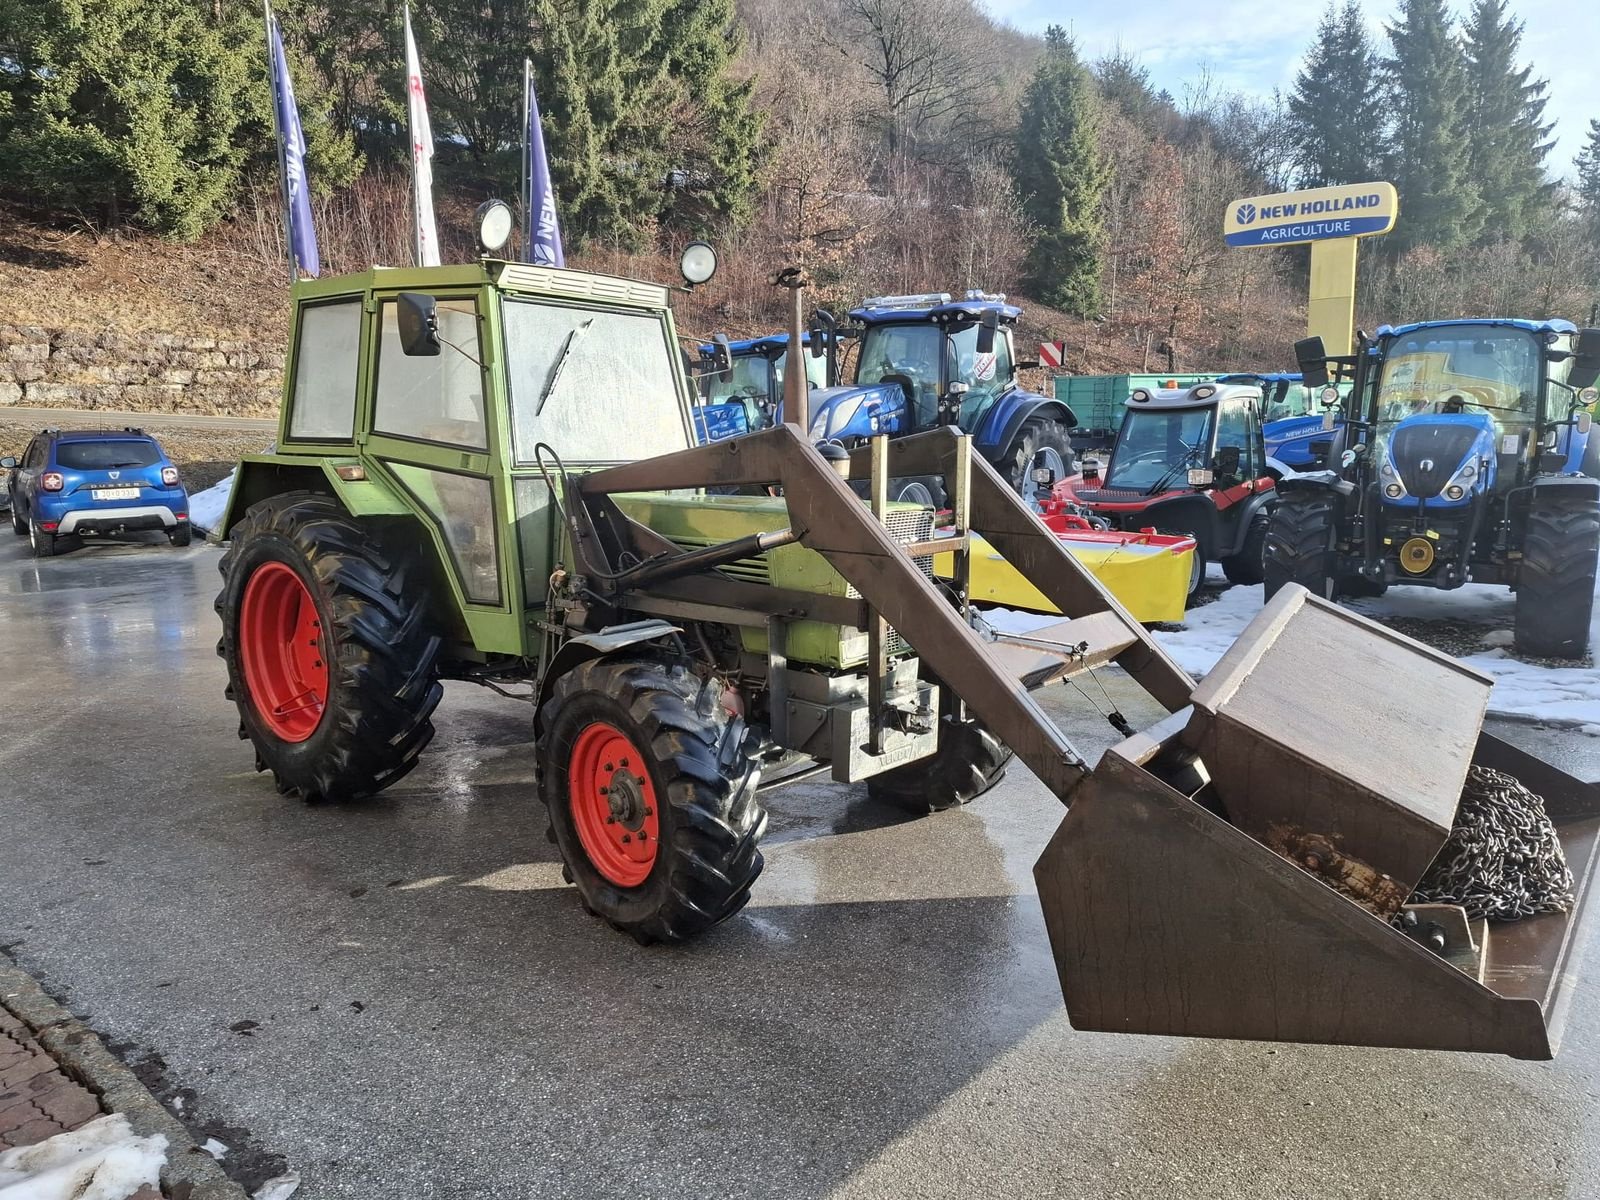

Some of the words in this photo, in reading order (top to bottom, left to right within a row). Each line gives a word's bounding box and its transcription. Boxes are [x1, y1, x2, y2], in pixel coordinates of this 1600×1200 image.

[1260, 203, 1298, 219] NEW
[1300, 194, 1381, 214] HOLLAND
[1260, 220, 1351, 241] AGRICULTURE
